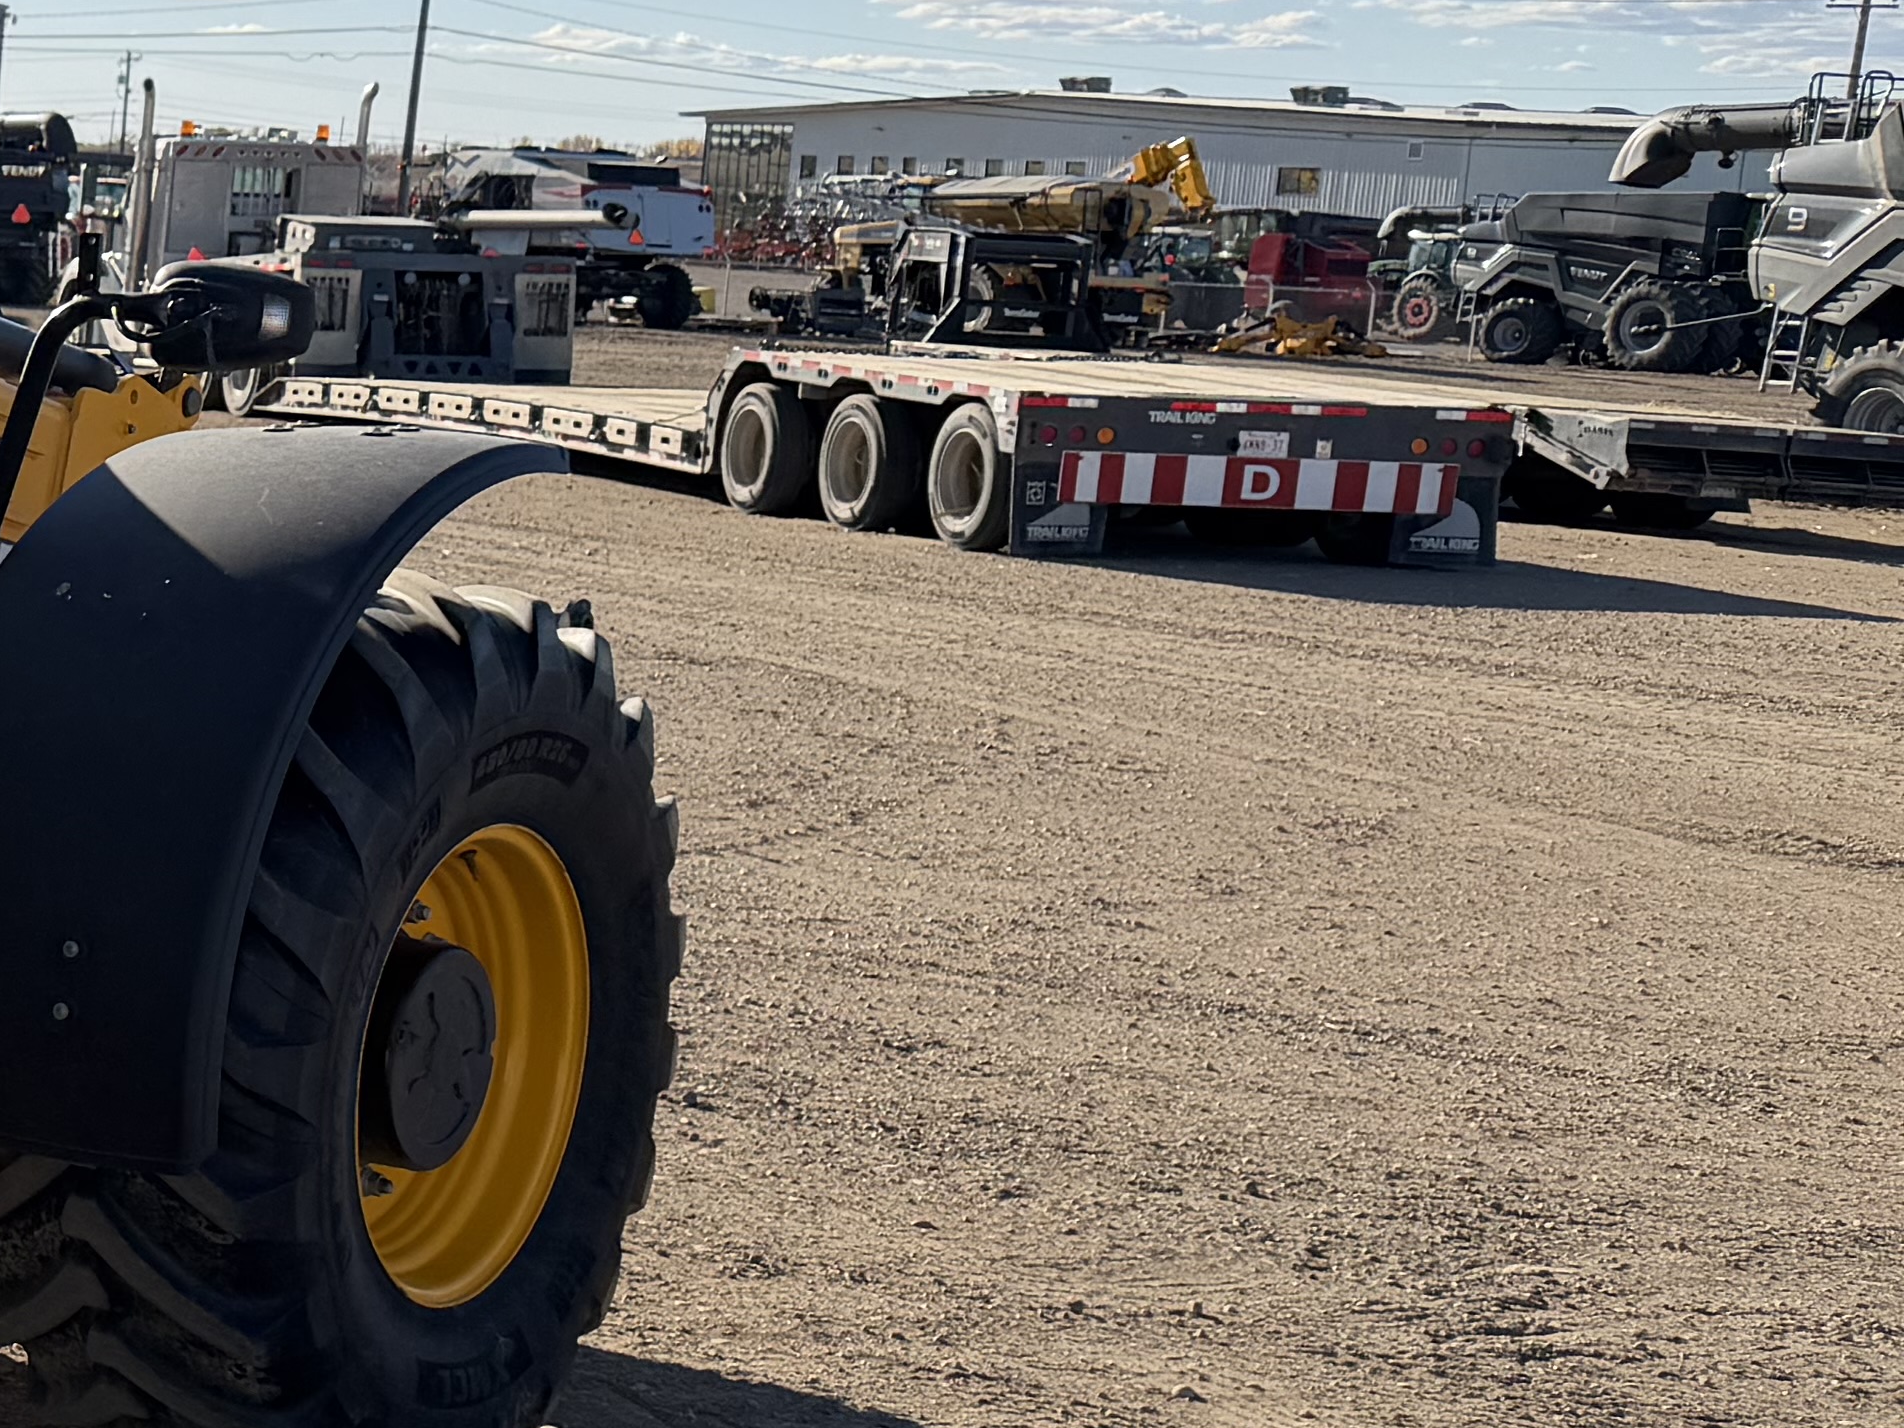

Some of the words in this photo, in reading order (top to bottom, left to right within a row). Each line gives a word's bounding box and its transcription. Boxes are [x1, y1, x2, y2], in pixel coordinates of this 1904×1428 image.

[1786, 206, 1808, 231] 9
[1148, 410, 1184, 424] TRAIL
[1185, 412, 1217, 424] KING
[1240, 464, 1280, 500] D
